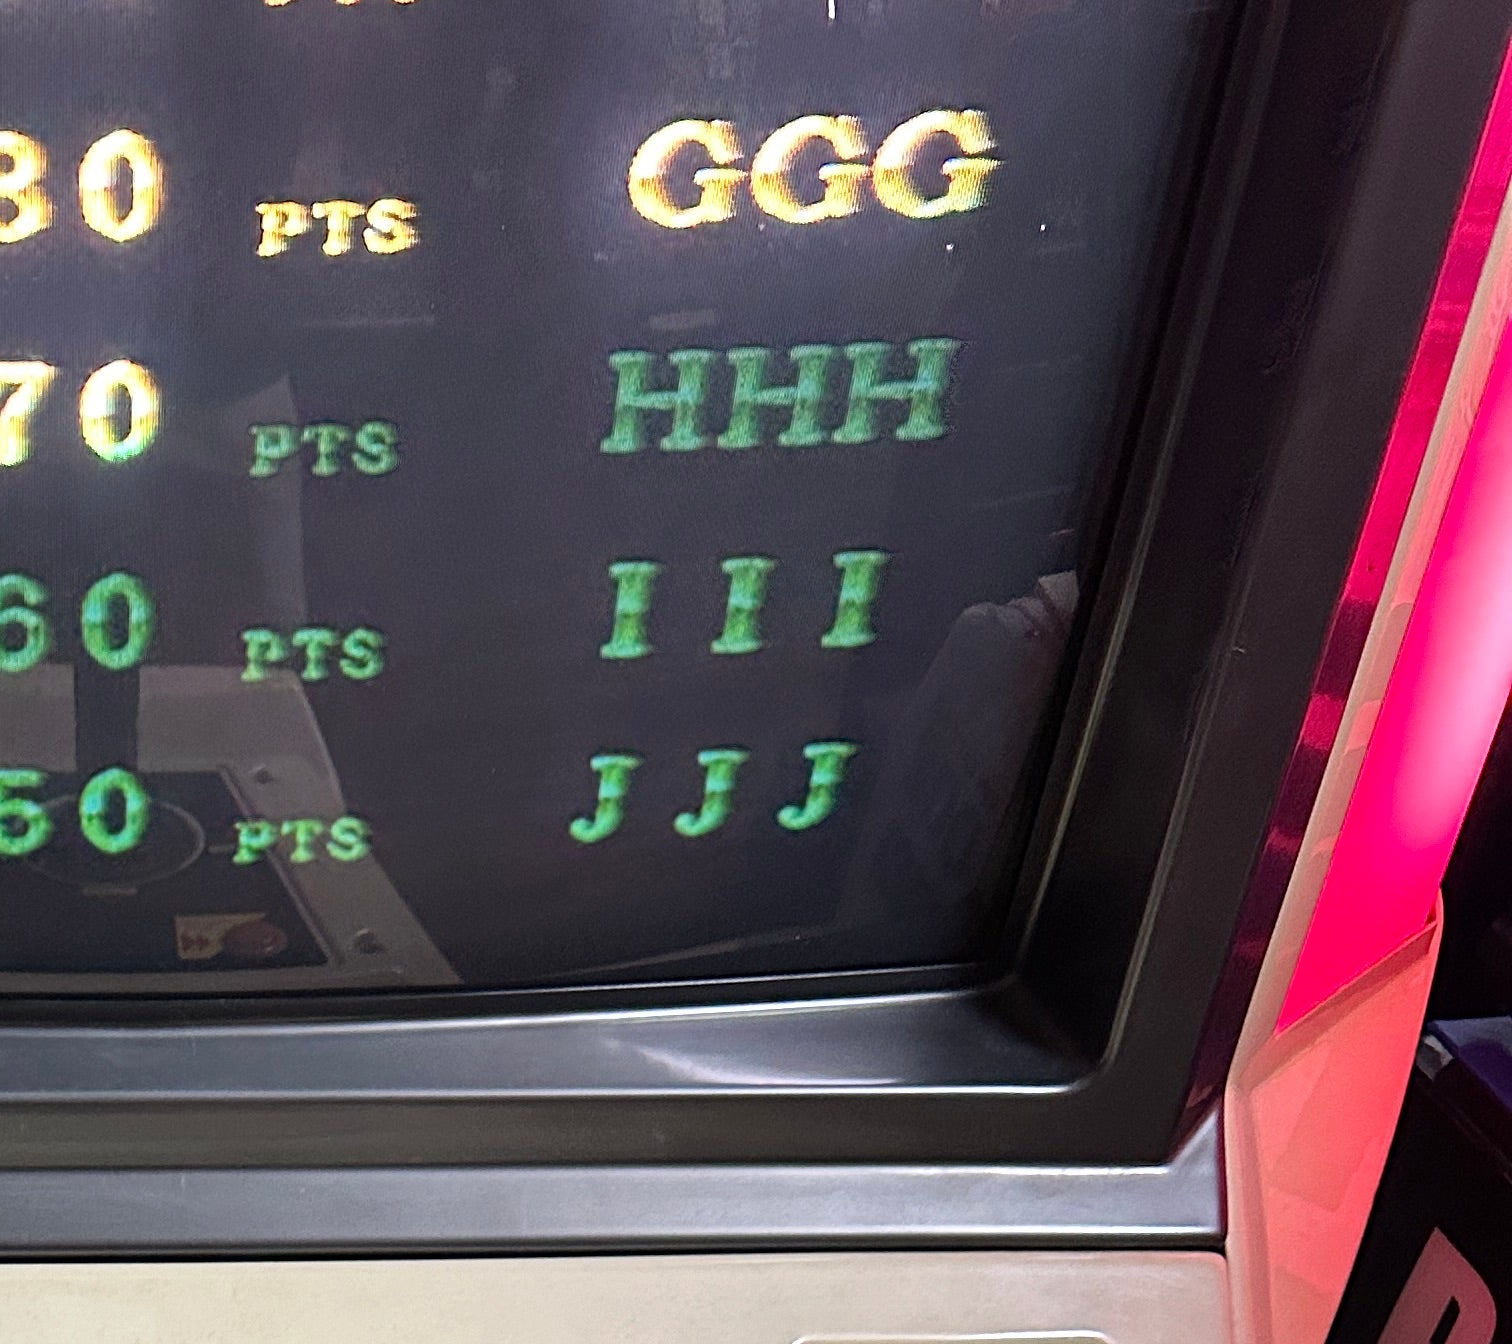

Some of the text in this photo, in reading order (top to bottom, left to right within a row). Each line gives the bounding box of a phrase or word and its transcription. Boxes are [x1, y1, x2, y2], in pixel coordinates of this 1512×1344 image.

[254, 197, 420, 258] PTS
[626, 108, 1002, 231] GGG
[249, 422, 396, 478] PTS
[599, 338, 958, 454] HHH
[240, 628, 386, 683] PTS
[232, 816, 372, 864] PTS
